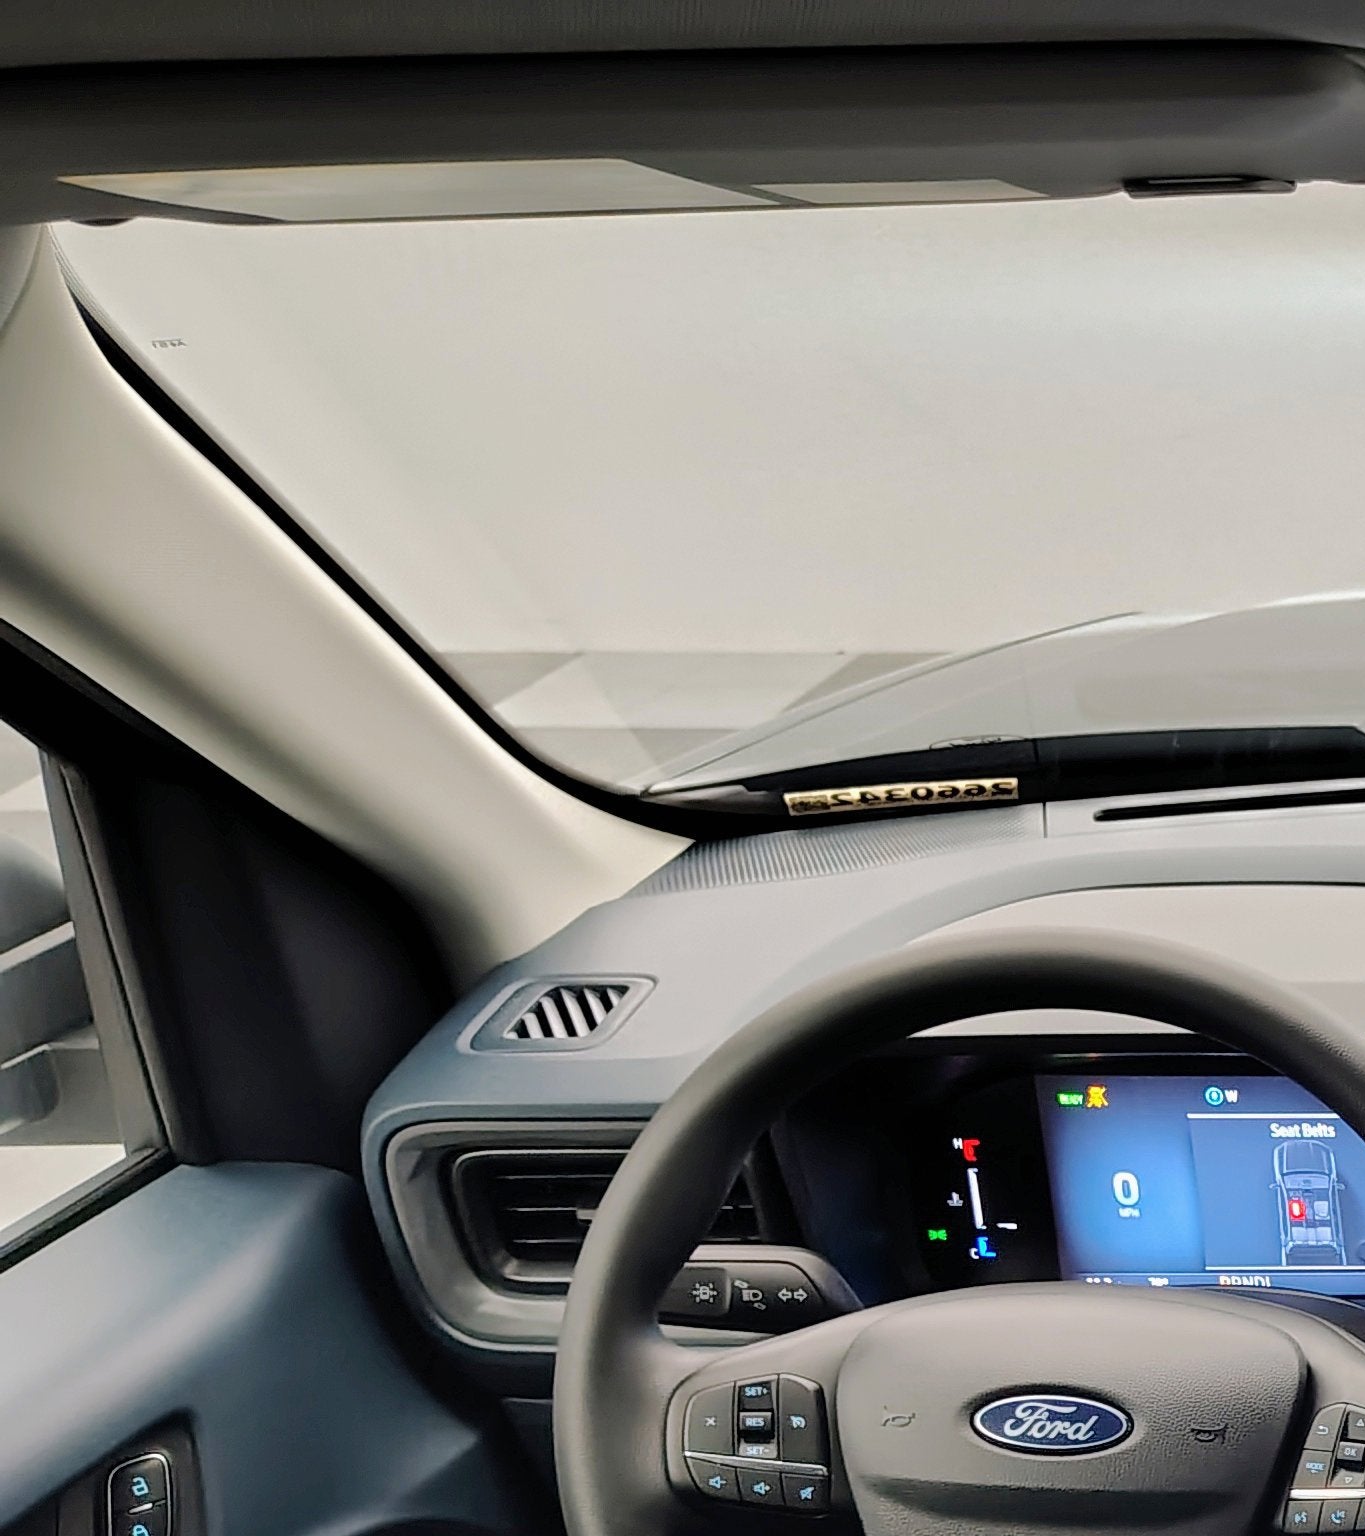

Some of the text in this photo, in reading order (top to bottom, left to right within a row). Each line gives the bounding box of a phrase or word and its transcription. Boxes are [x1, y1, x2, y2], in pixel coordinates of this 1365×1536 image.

[1225, 1090, 1238, 1102] W
[1270, 1122, 1336, 1138] Seat Belts
[1112, 1171, 1140, 1206] 0
[744, 1417, 766, 1428] RES
[1004, 1402, 1099, 1441] Ford
